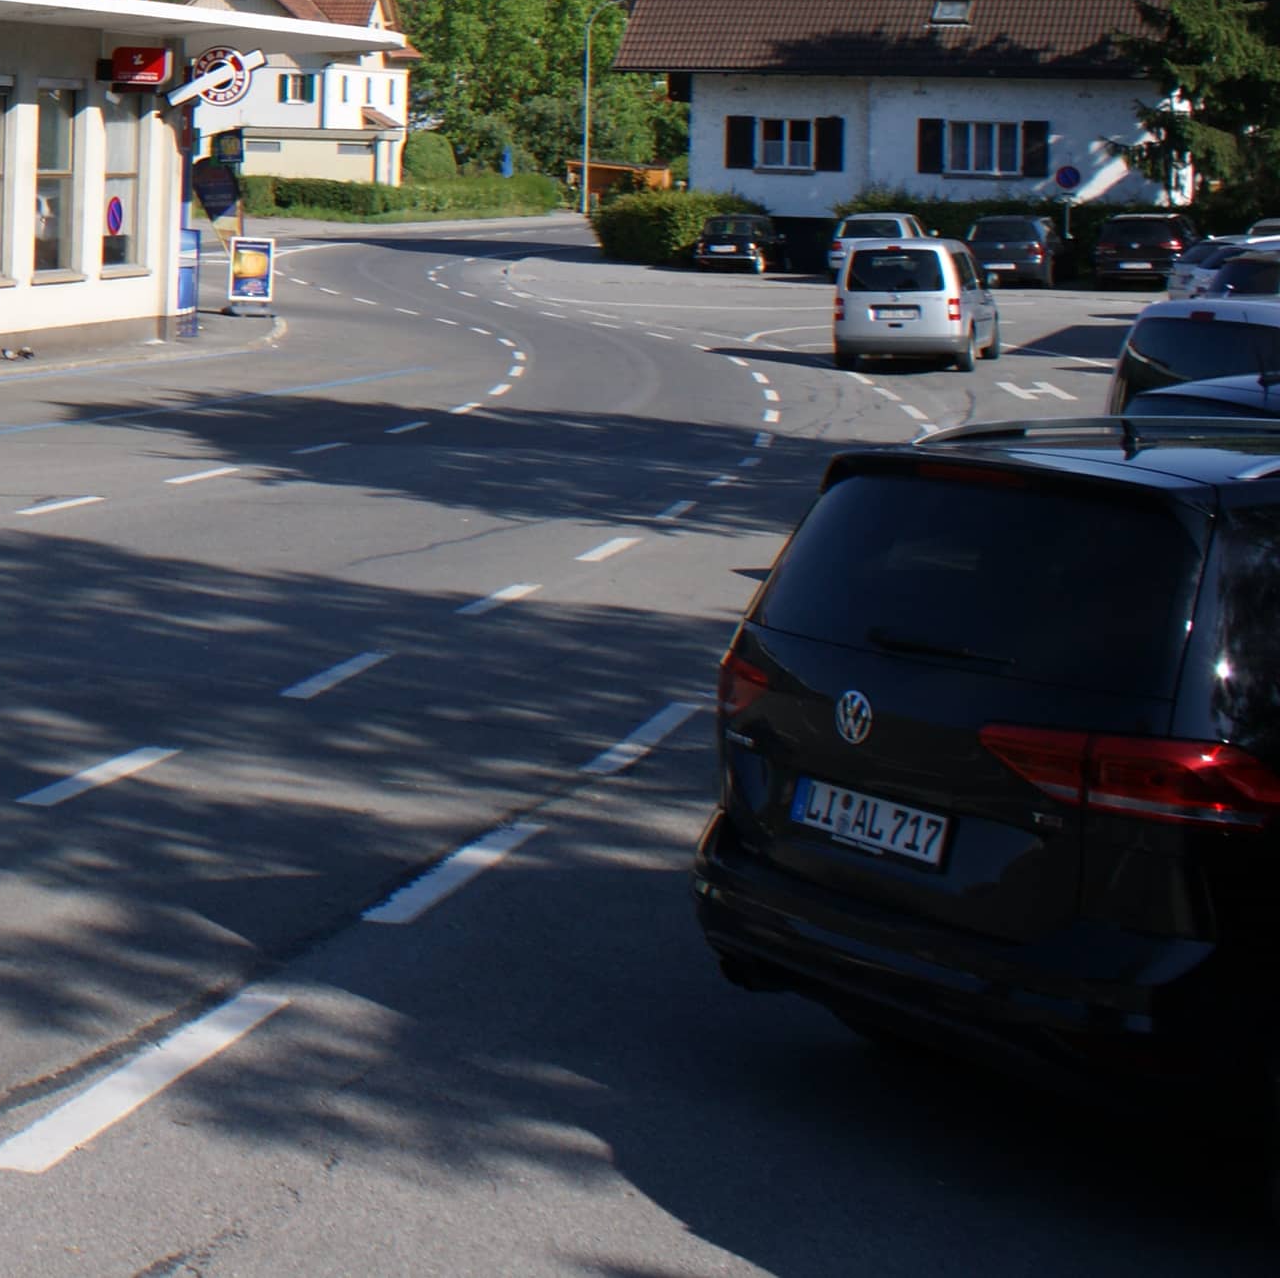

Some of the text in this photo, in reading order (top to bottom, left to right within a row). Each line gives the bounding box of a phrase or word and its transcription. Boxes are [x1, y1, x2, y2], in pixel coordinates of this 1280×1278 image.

[806, 785, 837, 825] LI
[851, 799, 883, 840] AL
[890, 809, 942, 855] 717
